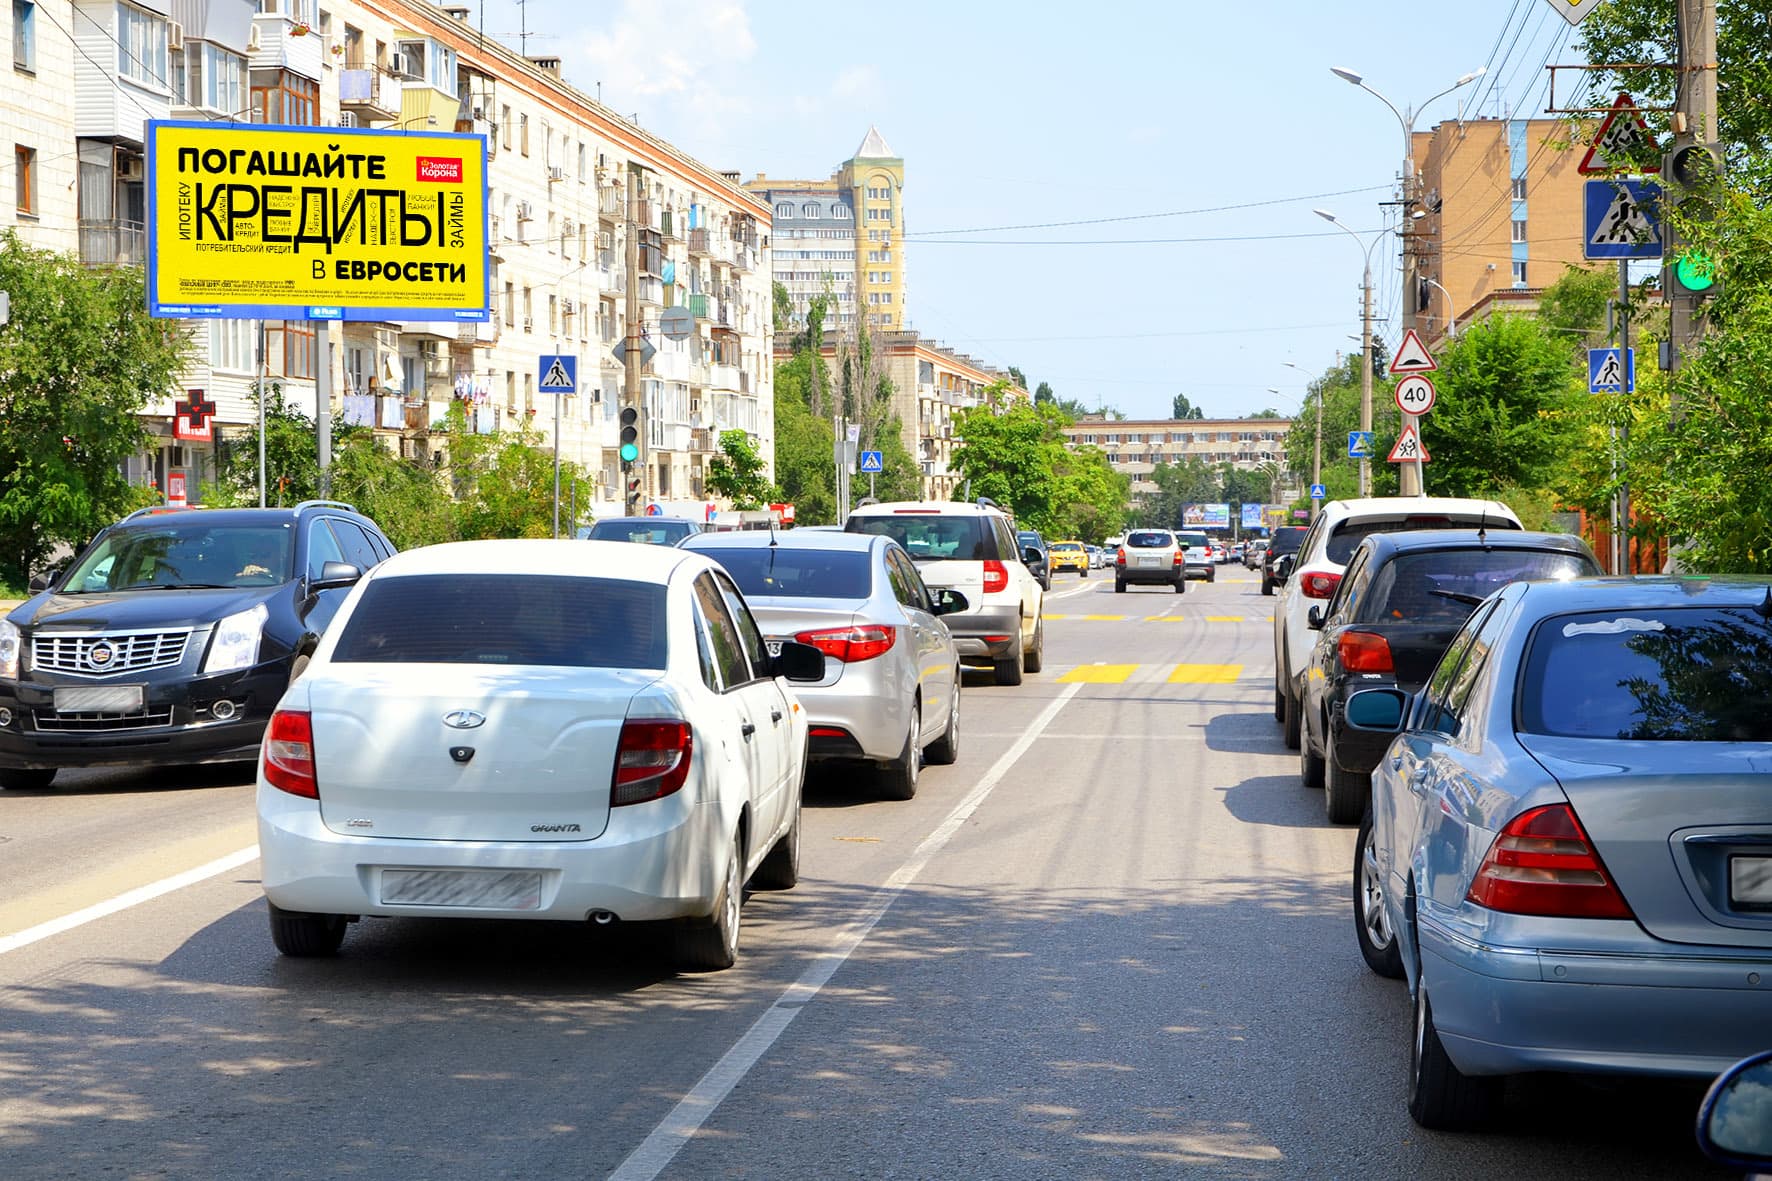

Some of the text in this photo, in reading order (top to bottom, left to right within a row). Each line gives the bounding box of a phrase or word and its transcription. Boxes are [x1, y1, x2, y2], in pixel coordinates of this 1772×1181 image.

[178, 143, 386, 180] ПОГАШАЙТЕ
[421, 167, 458, 178] Корона
[178, 182, 191, 240] ИПОТЕКУ
[195, 182, 445, 254] КРЕДИТЫ
[448, 191, 464, 248] ЗАЙМЫ
[196, 243, 292, 255] ПОТРЕБИТЕЛЬСКИЙ КРЕДИТ
[312, 259, 466, 282] В ЕВРОСЕТИ
[1404, 387, 1426, 402] 40
[530, 823, 581, 832] GRANTA
